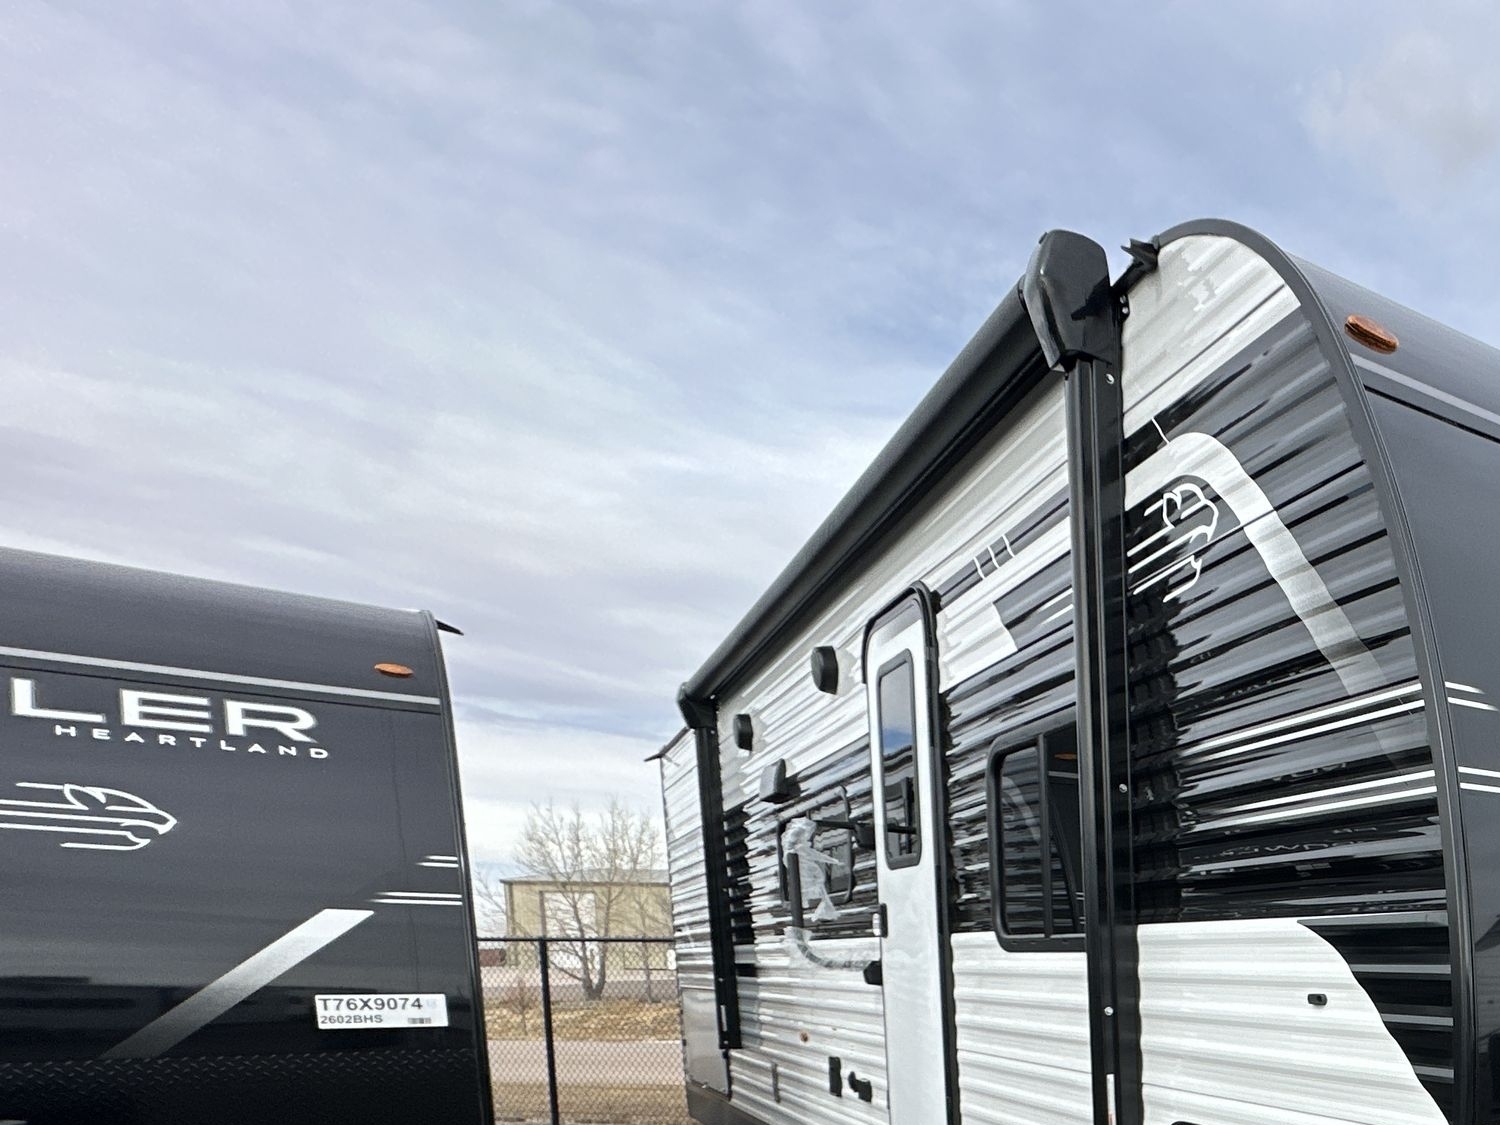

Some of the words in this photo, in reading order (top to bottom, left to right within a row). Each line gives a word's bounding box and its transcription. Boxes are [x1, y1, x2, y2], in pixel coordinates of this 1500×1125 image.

[10, 677, 318, 743] LER
[54, 724, 328, 759] HEARTLAND
[317, 998, 423, 1011] T76X9074
[319, 1014, 384, 1025] 2602BHS
